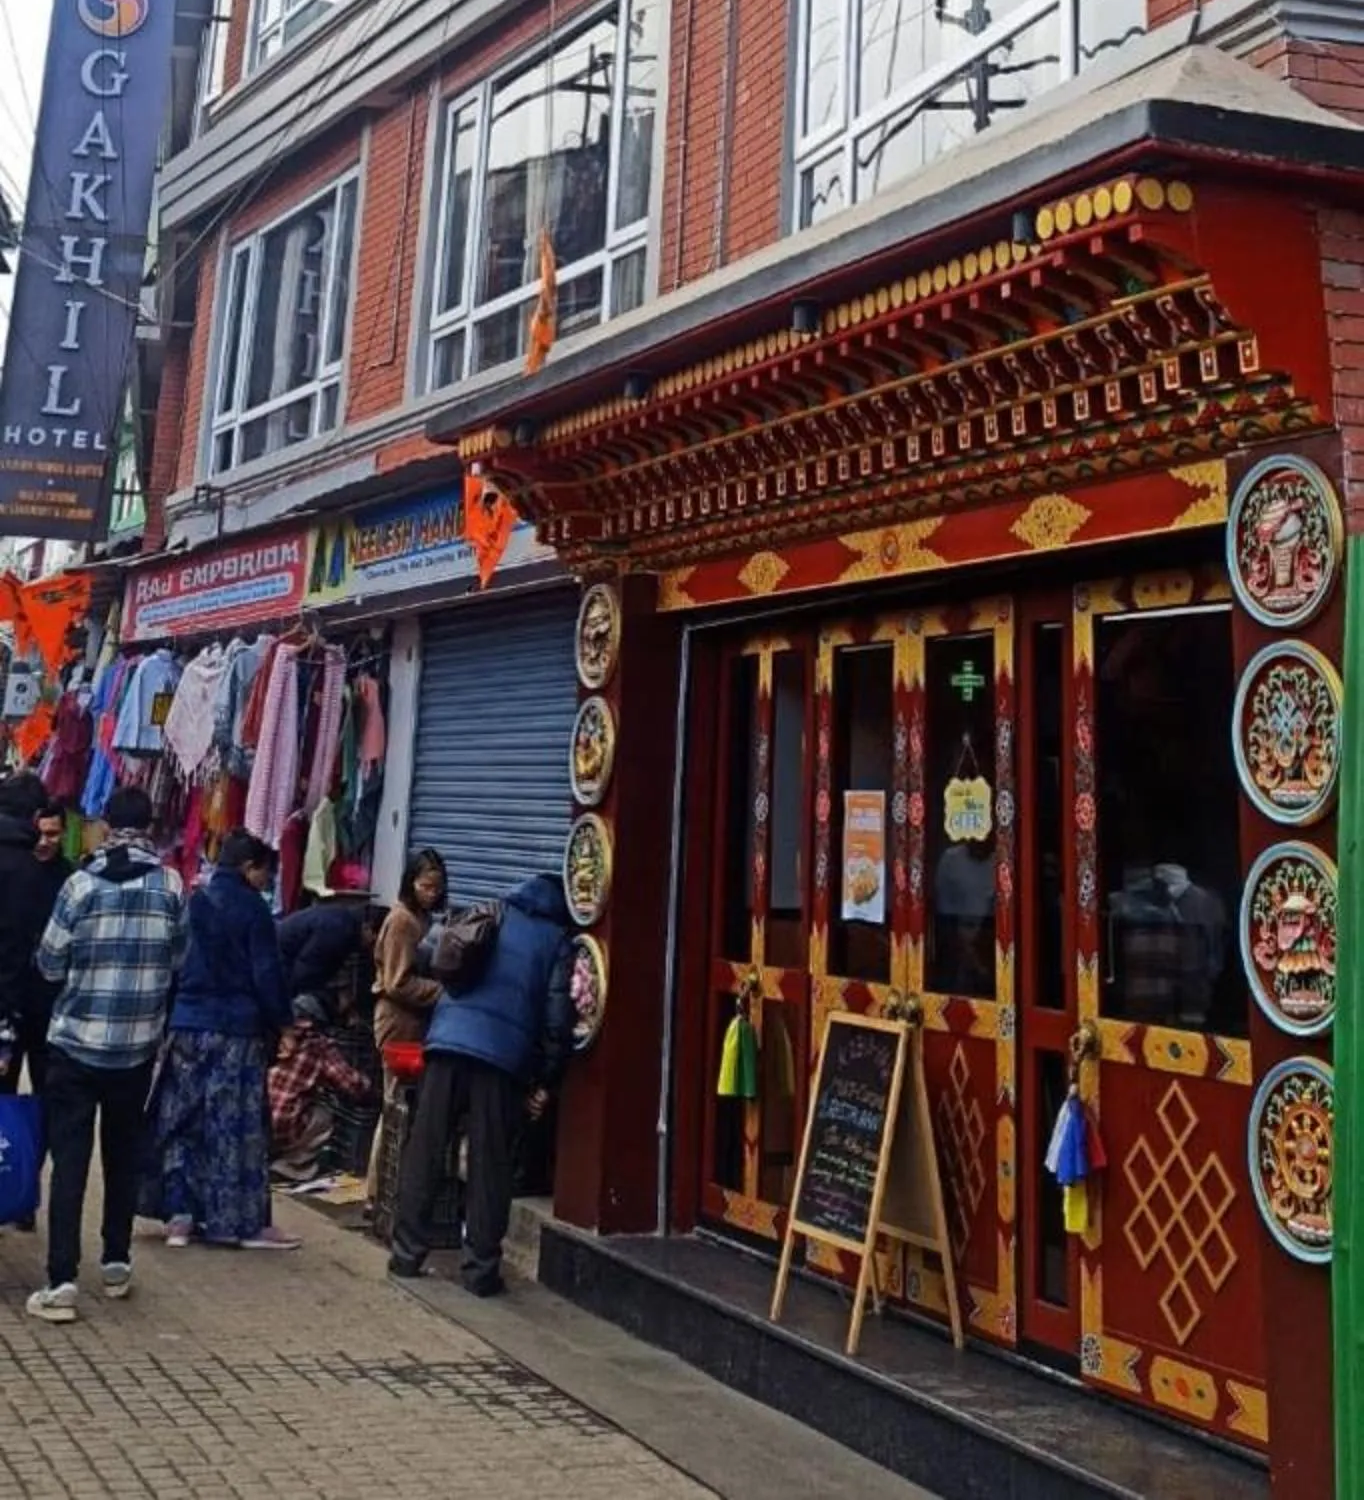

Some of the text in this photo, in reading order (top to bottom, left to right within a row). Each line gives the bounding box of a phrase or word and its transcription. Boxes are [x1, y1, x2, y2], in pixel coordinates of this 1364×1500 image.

[40, 49, 130, 417] GAKHIL
[4, 425, 107, 451] HOTEL
[135, 573, 174, 604] RAJ
